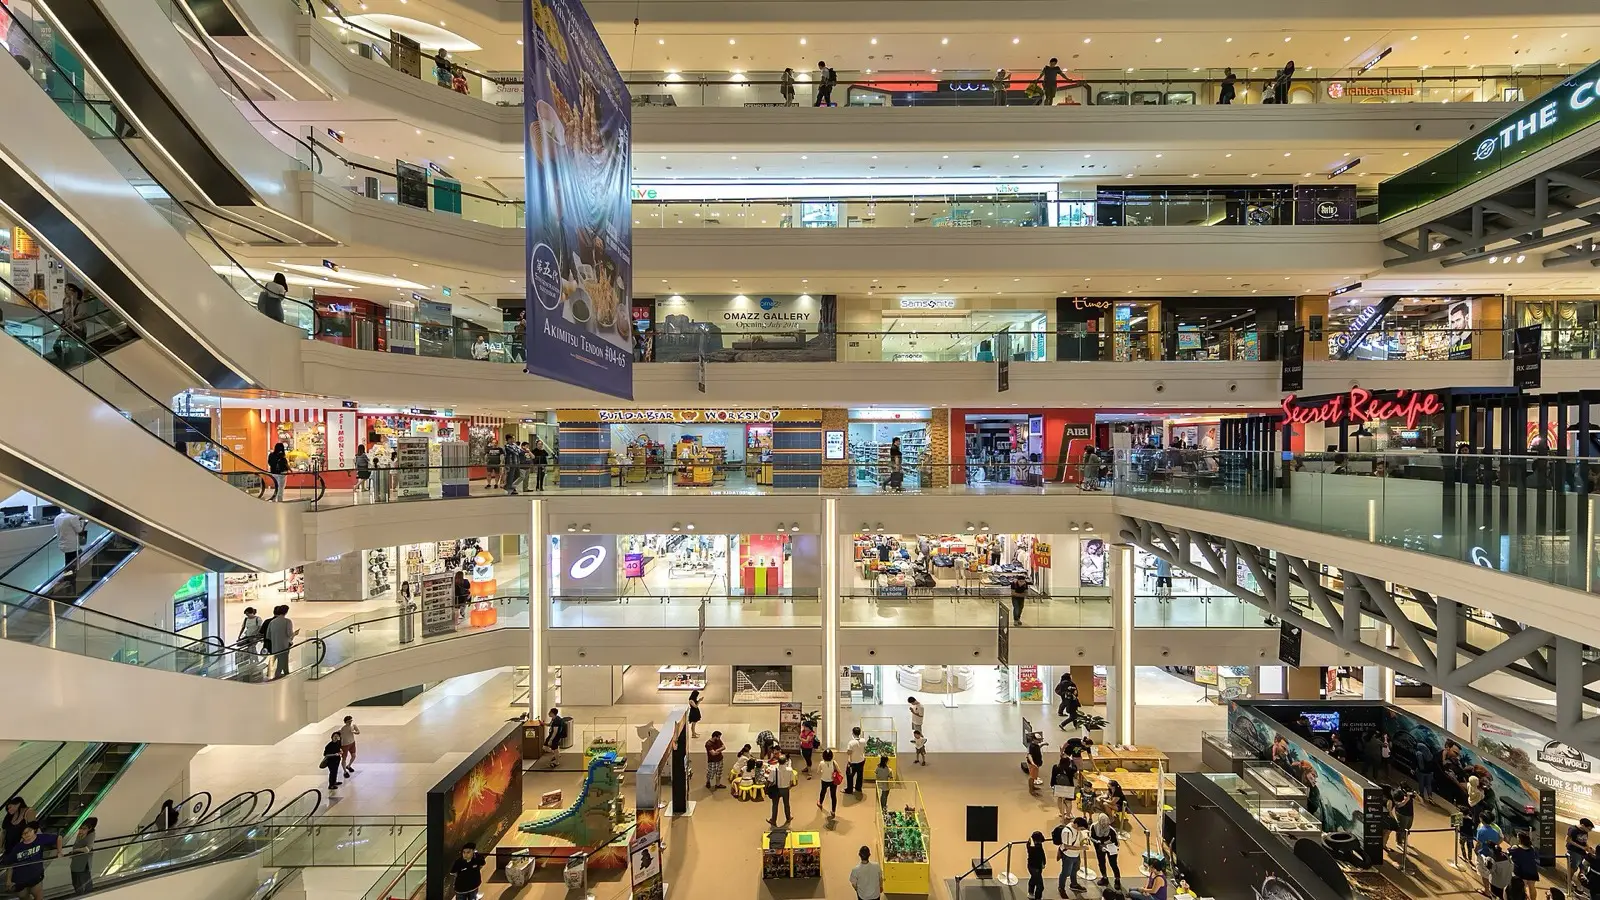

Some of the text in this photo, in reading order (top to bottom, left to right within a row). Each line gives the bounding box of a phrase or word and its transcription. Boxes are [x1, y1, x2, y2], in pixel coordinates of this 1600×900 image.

[1346, 86, 1384, 95] ichiban
[1500, 101, 1557, 149] THE
[901, 299, 954, 309] Samsonite
[1072, 296, 1112, 310] times
[763, 312, 811, 321] GALLERY
[736, 321, 767, 330] Opening
[604, 345, 626, 368] #04-65
[1282, 387, 1439, 430] Secret Recipe
[1066, 428, 1089, 436] AIBI
[1563, 757, 1589, 770] WORLD
[1565, 782, 1573, 791] &
[1573, 783, 1593, 797] ROAR
